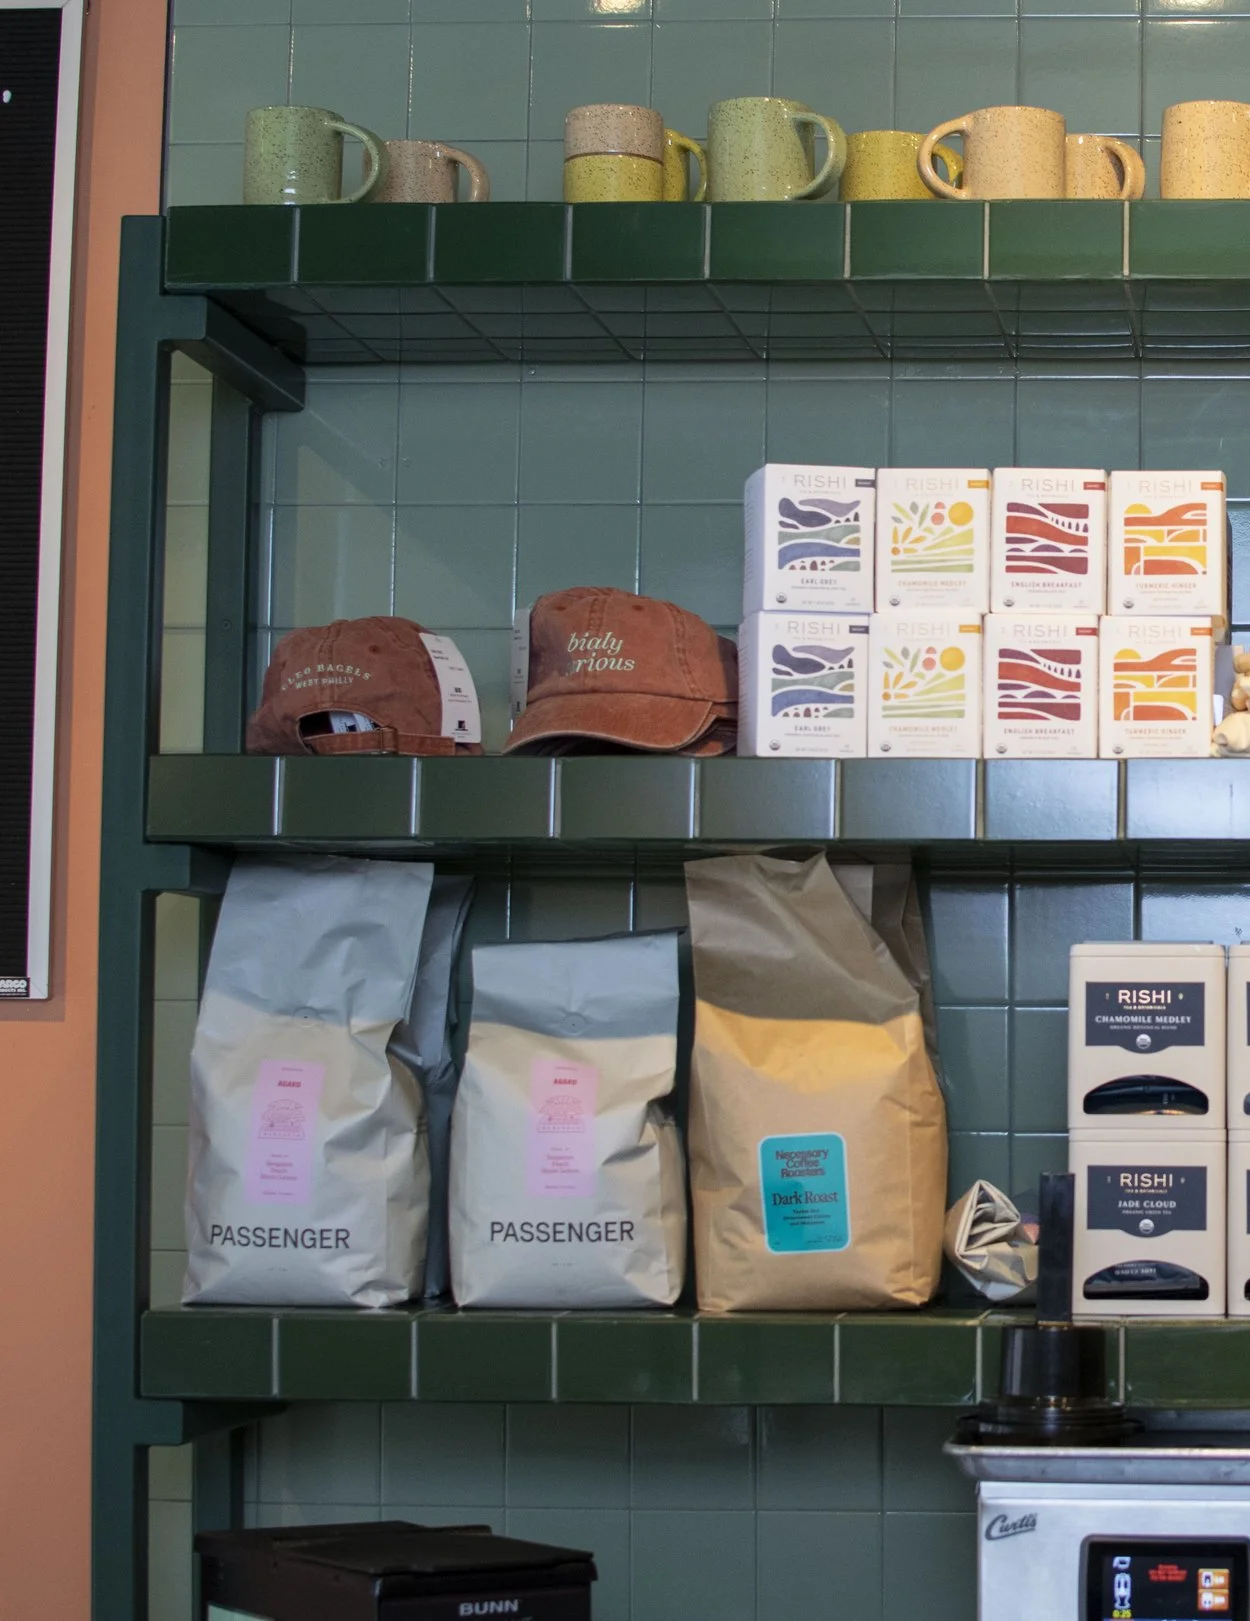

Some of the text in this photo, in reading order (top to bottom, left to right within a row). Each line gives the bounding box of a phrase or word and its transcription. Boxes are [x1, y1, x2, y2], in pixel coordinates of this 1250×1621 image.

[794, 475, 847, 489] RISHI
[906, 478, 959, 491] RISHI
[1021, 478, 1074, 492] RISHI
[1138, 479, 1192, 492] RISHI
[788, 621, 840, 635] RISHI
[897, 622, 950, 635] RISHI
[1013, 624, 1067, 637] RISHI
[1128, 625, 1182, 637] RISHI
[567, 631, 623, 655] bialy
[316, 664, 373, 680] BAGELS
[295, 678, 319, 688] WEST
[1118, 989, 1171, 1004] RISHI
[1095, 1015, 1191, 1023] CHAMOMILE MEDLEY
[775, 1149, 829, 1161] Necessary
[786, 1159, 820, 1169] Coffee
[781, 1168, 826, 1178] Roasters
[1120, 1173, 1173, 1187] RISHI
[772, 1191, 838, 1206] Dark Roast
[1118, 1200, 1177, 1208] JADE CLOUD
[210, 1224, 351, 1249] PASSENGER
[490, 1221, 635, 1243] PASSENGER
[984, 1512, 1038, 1541] Curtis
[459, 1599, 519, 1616] BUNN
